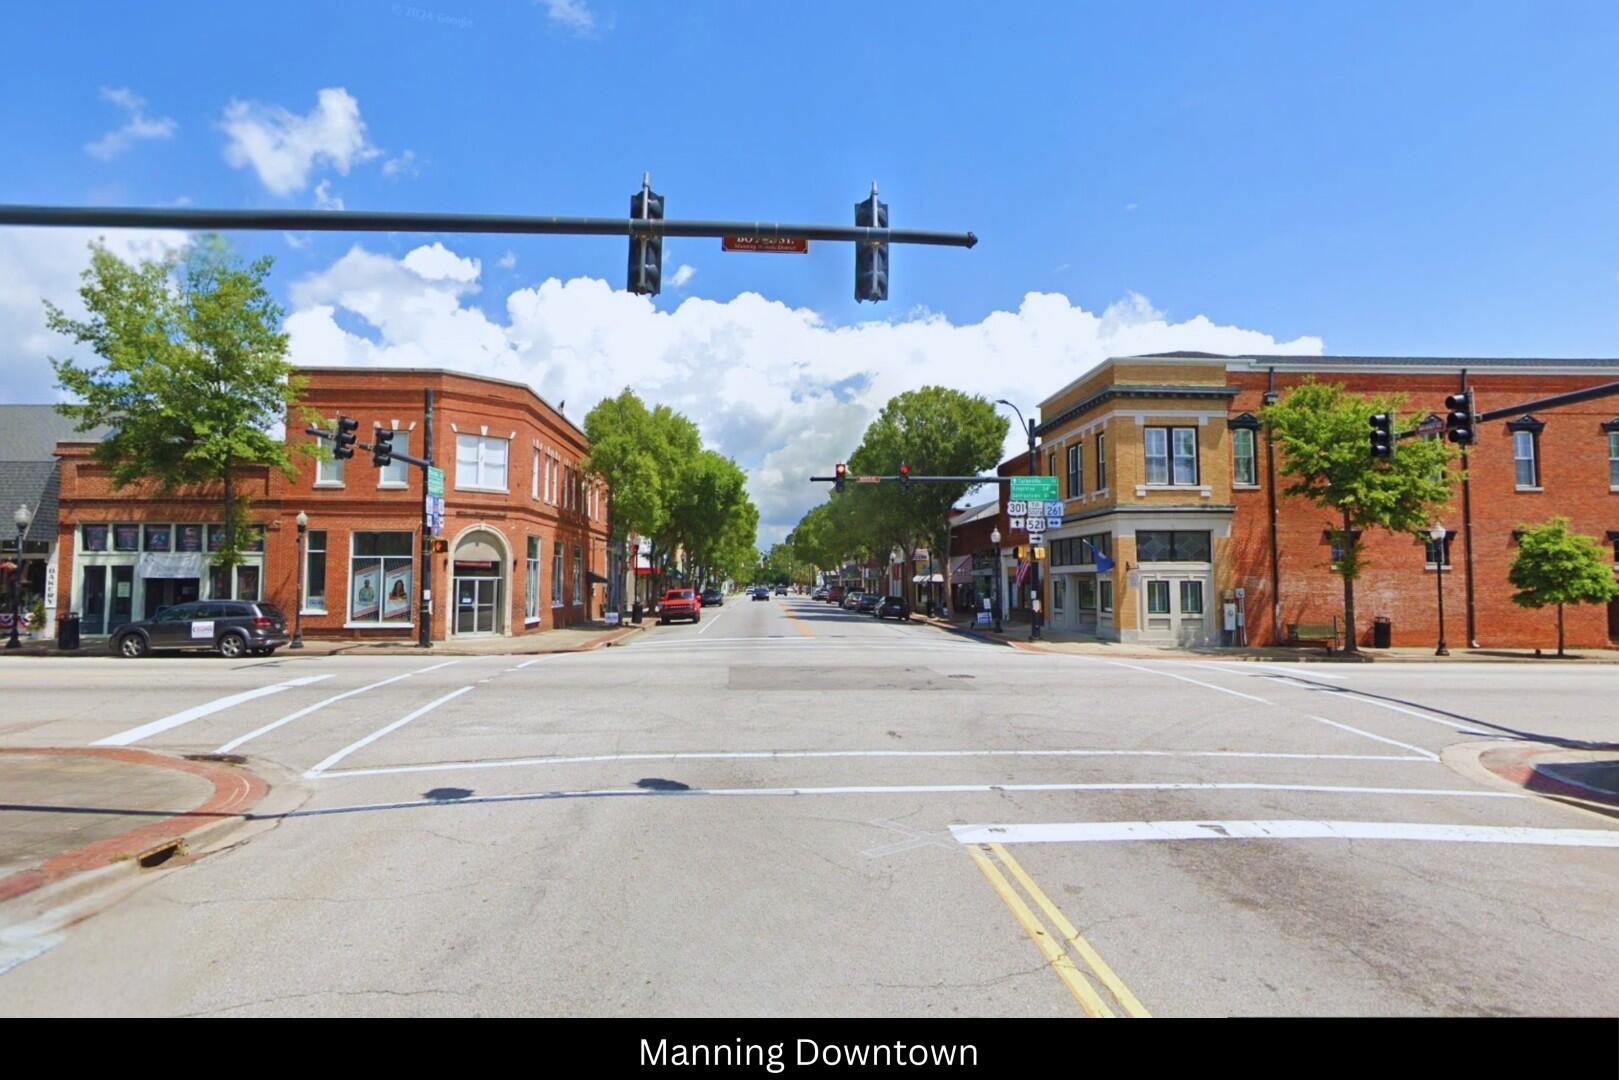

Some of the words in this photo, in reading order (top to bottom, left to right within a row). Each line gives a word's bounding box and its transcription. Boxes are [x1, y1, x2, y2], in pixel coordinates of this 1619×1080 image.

[1010, 503, 1025, 513] 301
[1047, 506, 1061, 515] 261
[1028, 520, 1044, 529] 521
